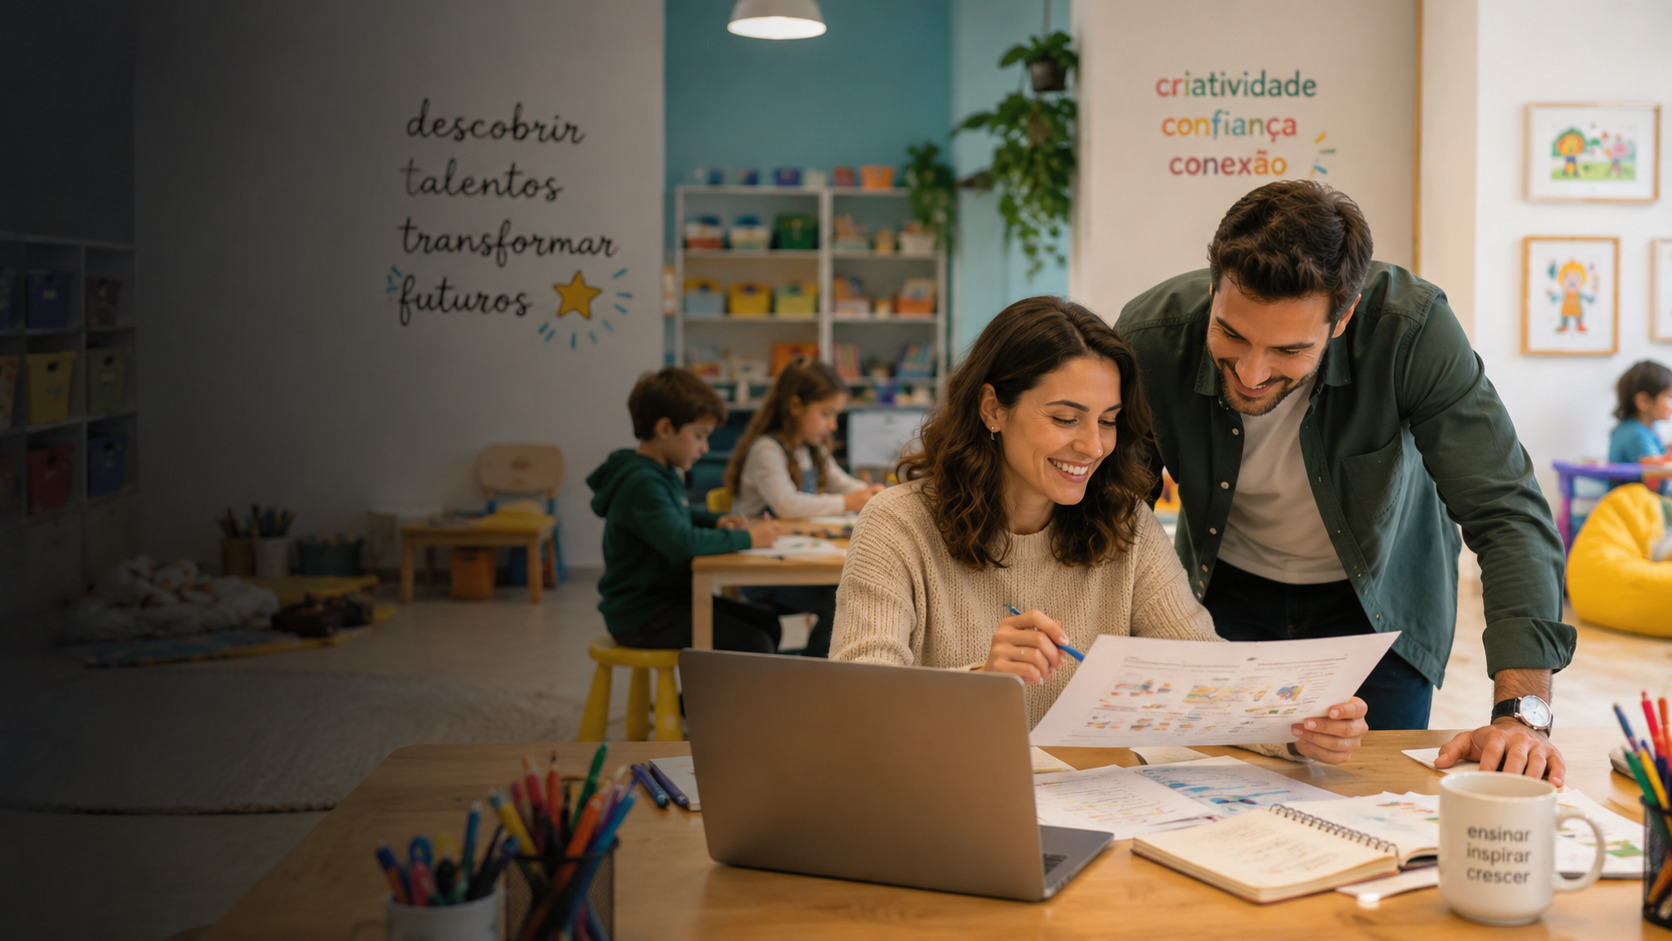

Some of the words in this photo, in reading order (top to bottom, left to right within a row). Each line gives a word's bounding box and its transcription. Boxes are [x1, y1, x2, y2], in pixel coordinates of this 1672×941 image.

[1155, 69, 1317, 97] criatividade
[406, 97, 586, 144] descobrir
[1161, 109, 1298, 143] confiança
[1169, 149, 1288, 176] conexão
[400, 157, 564, 201] talentos
[397, 216, 618, 268] transformar
[398, 274, 533, 327] futuros
[1467, 825, 1531, 843] ensinar
[1466, 843, 1531, 866] inspirar
[1466, 867, 1530, 885] crescer
